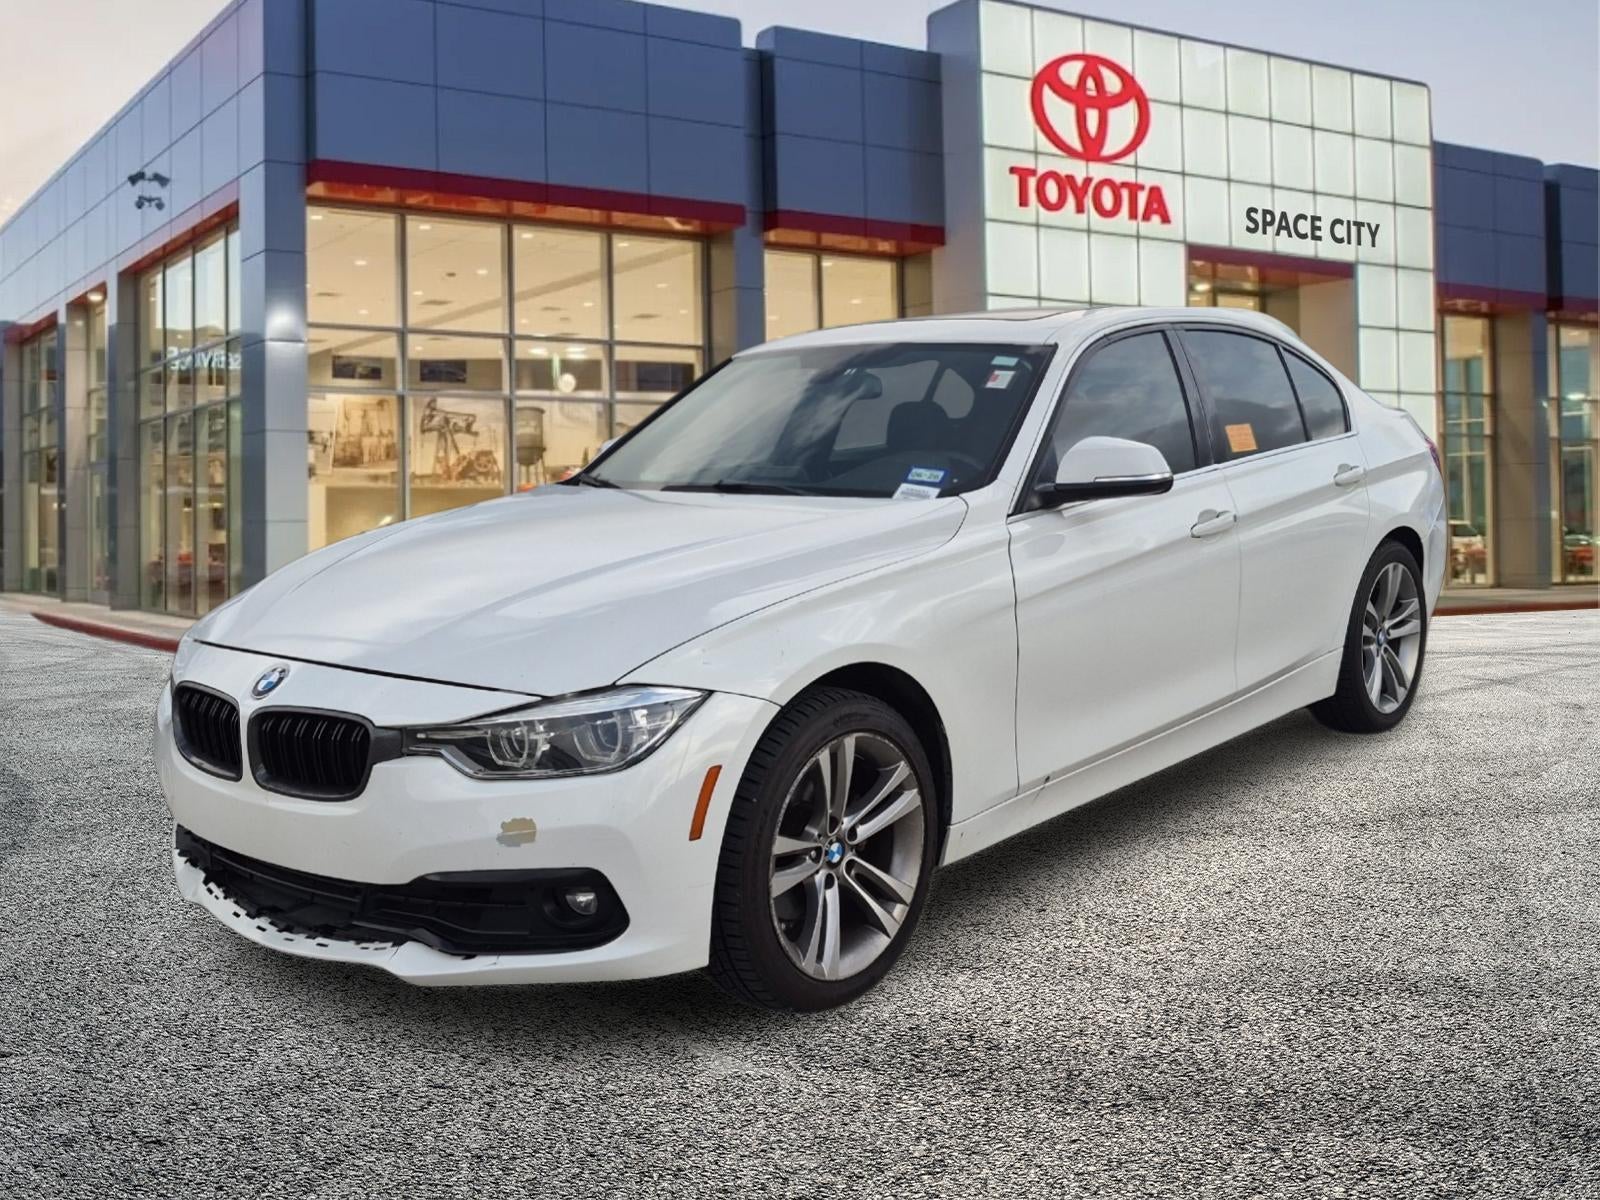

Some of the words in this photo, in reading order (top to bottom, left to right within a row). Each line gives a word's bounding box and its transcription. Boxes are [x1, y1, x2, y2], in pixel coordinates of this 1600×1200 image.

[1009, 166, 1171, 224] TOYOTA
[1245, 206, 1322, 241] SPACE
[1329, 218, 1381, 248] CITY
